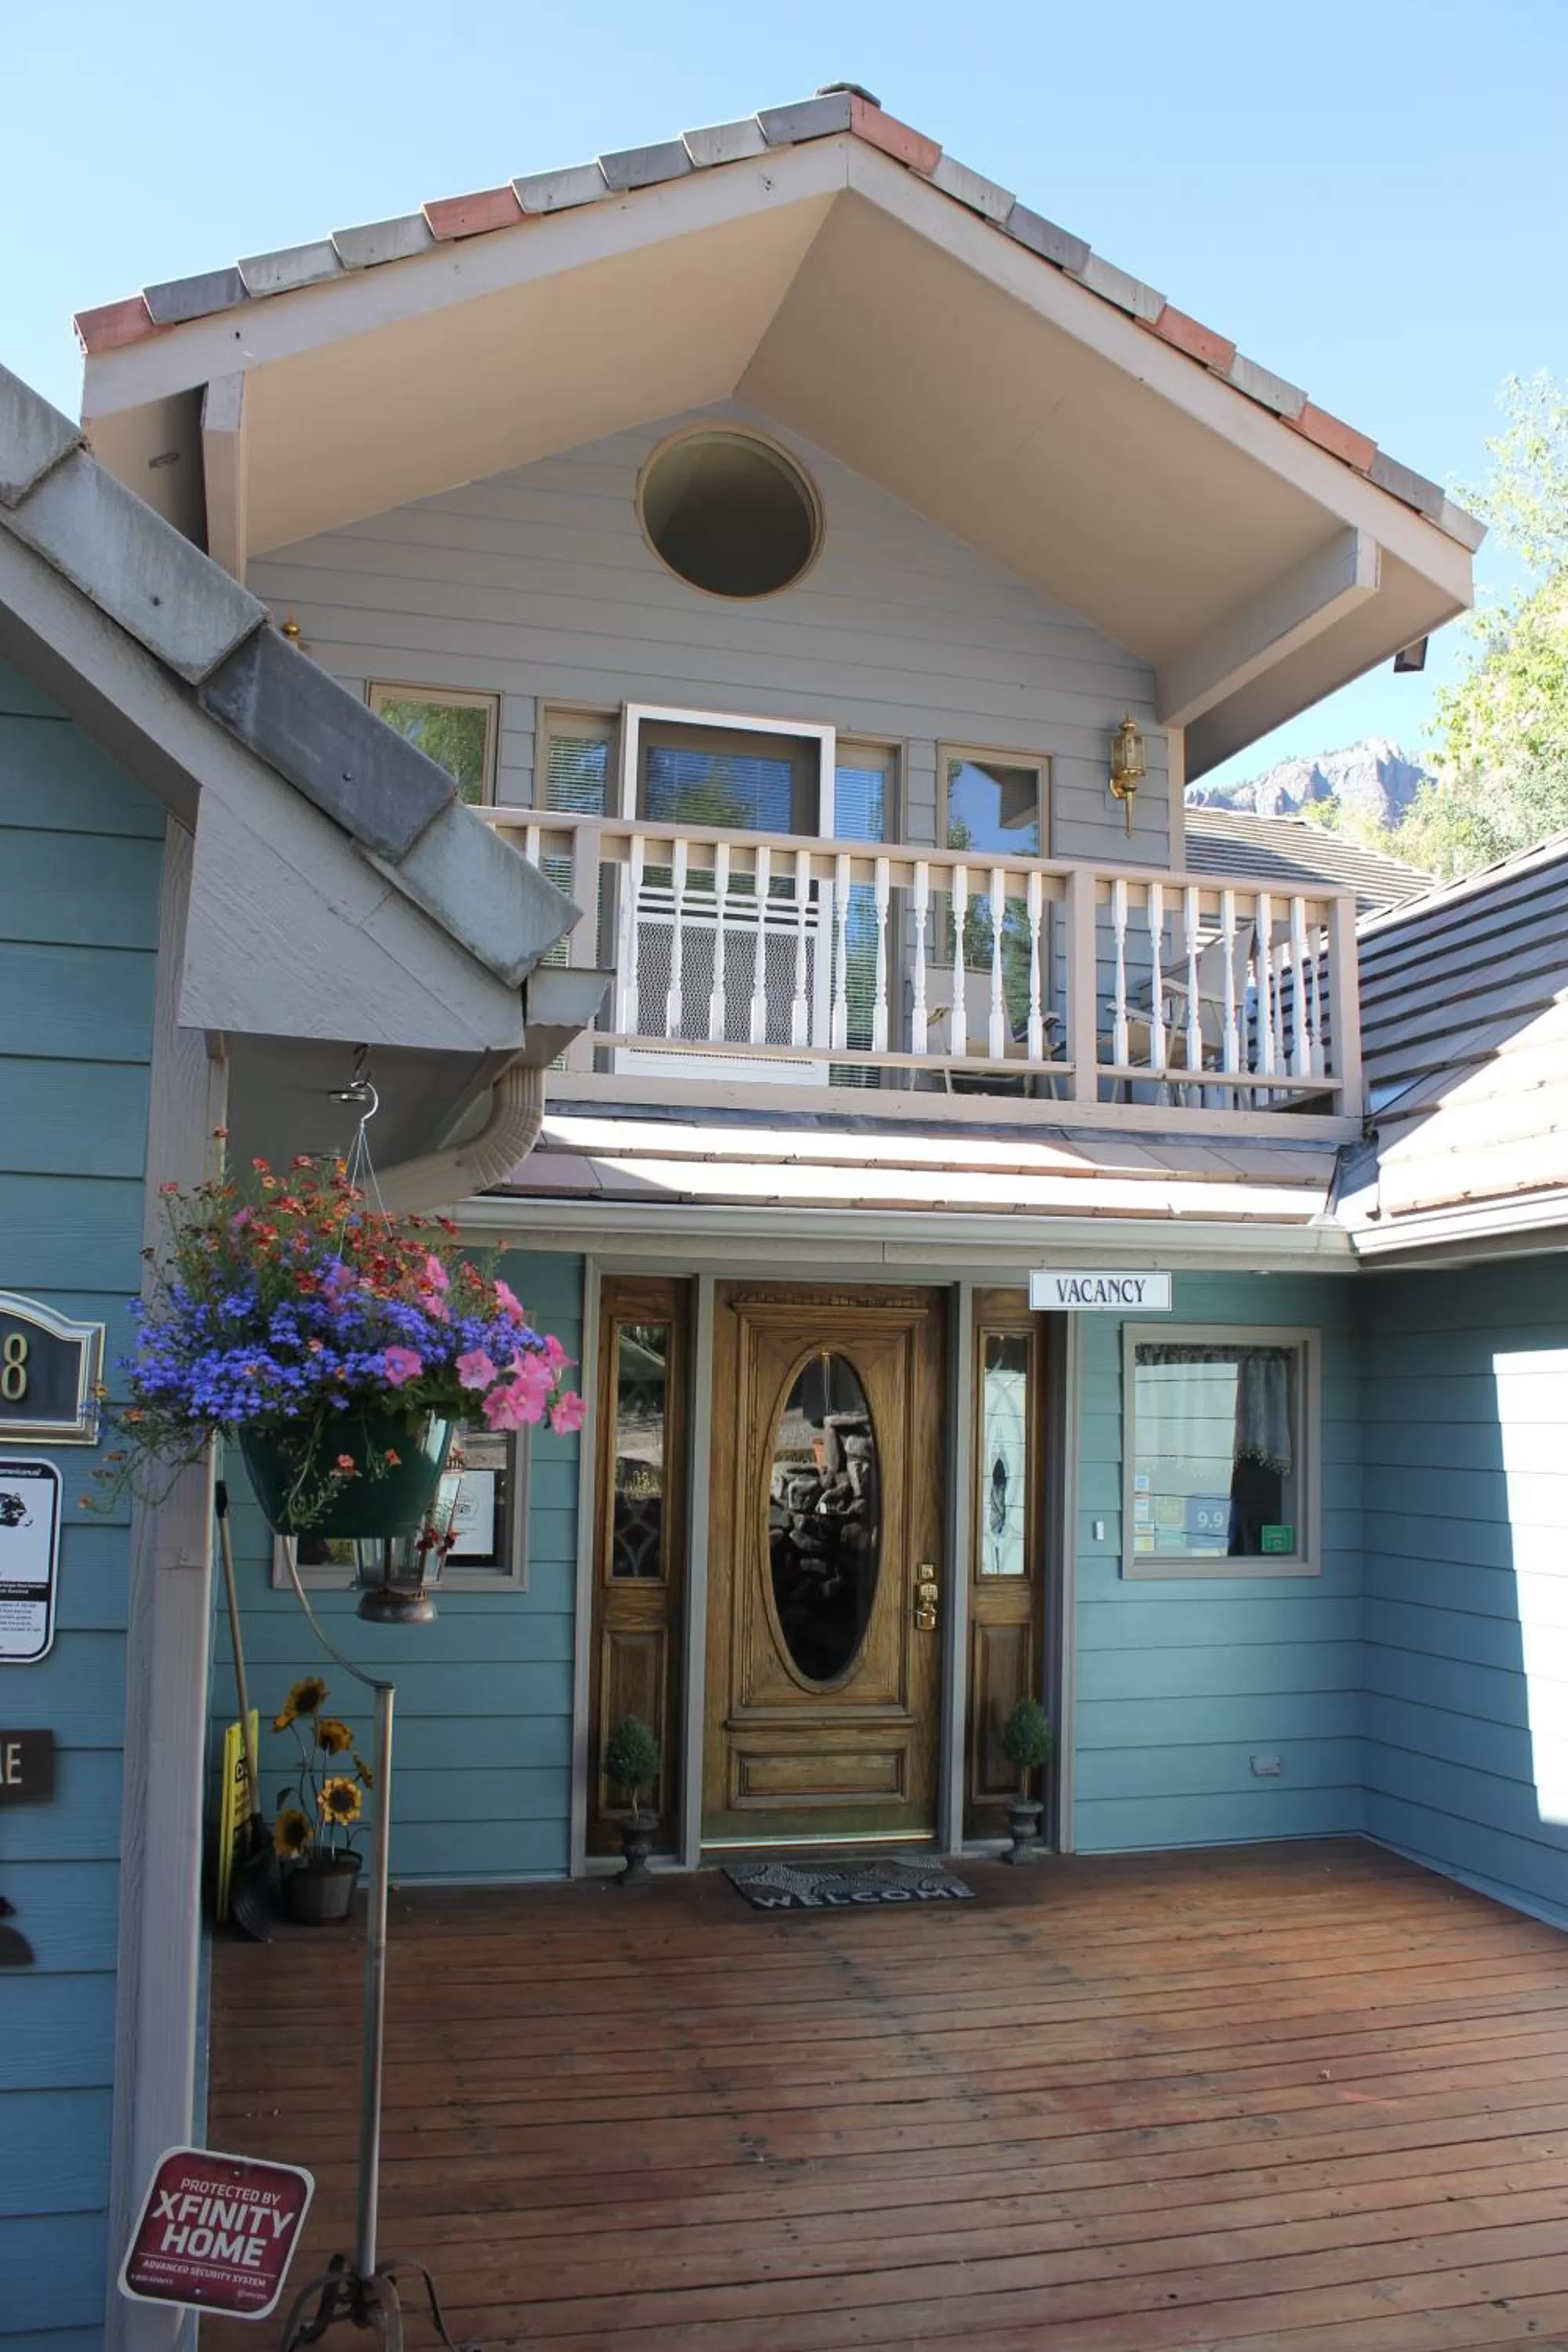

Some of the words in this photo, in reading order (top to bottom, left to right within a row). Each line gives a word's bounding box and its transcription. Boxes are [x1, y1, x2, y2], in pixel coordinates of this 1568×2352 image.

[1056, 1279, 1146, 1304] VACANCY
[2, 1333, 28, 1400] 8
[1197, 1511, 1224, 1529] 9.9
[751, 1889, 978, 1907] WELCOME
[180, 2177, 260, 2202] PROTECTED
[262, 2191, 281, 2205] BY
[152, 2189, 296, 2239] XFINITY
[160, 2223, 267, 2267] HOME
[142, 2259, 188, 2274] ADVANCED
[190, 2266, 231, 2282] SECURITY
[232, 2273, 267, 2287] SYSTEM
